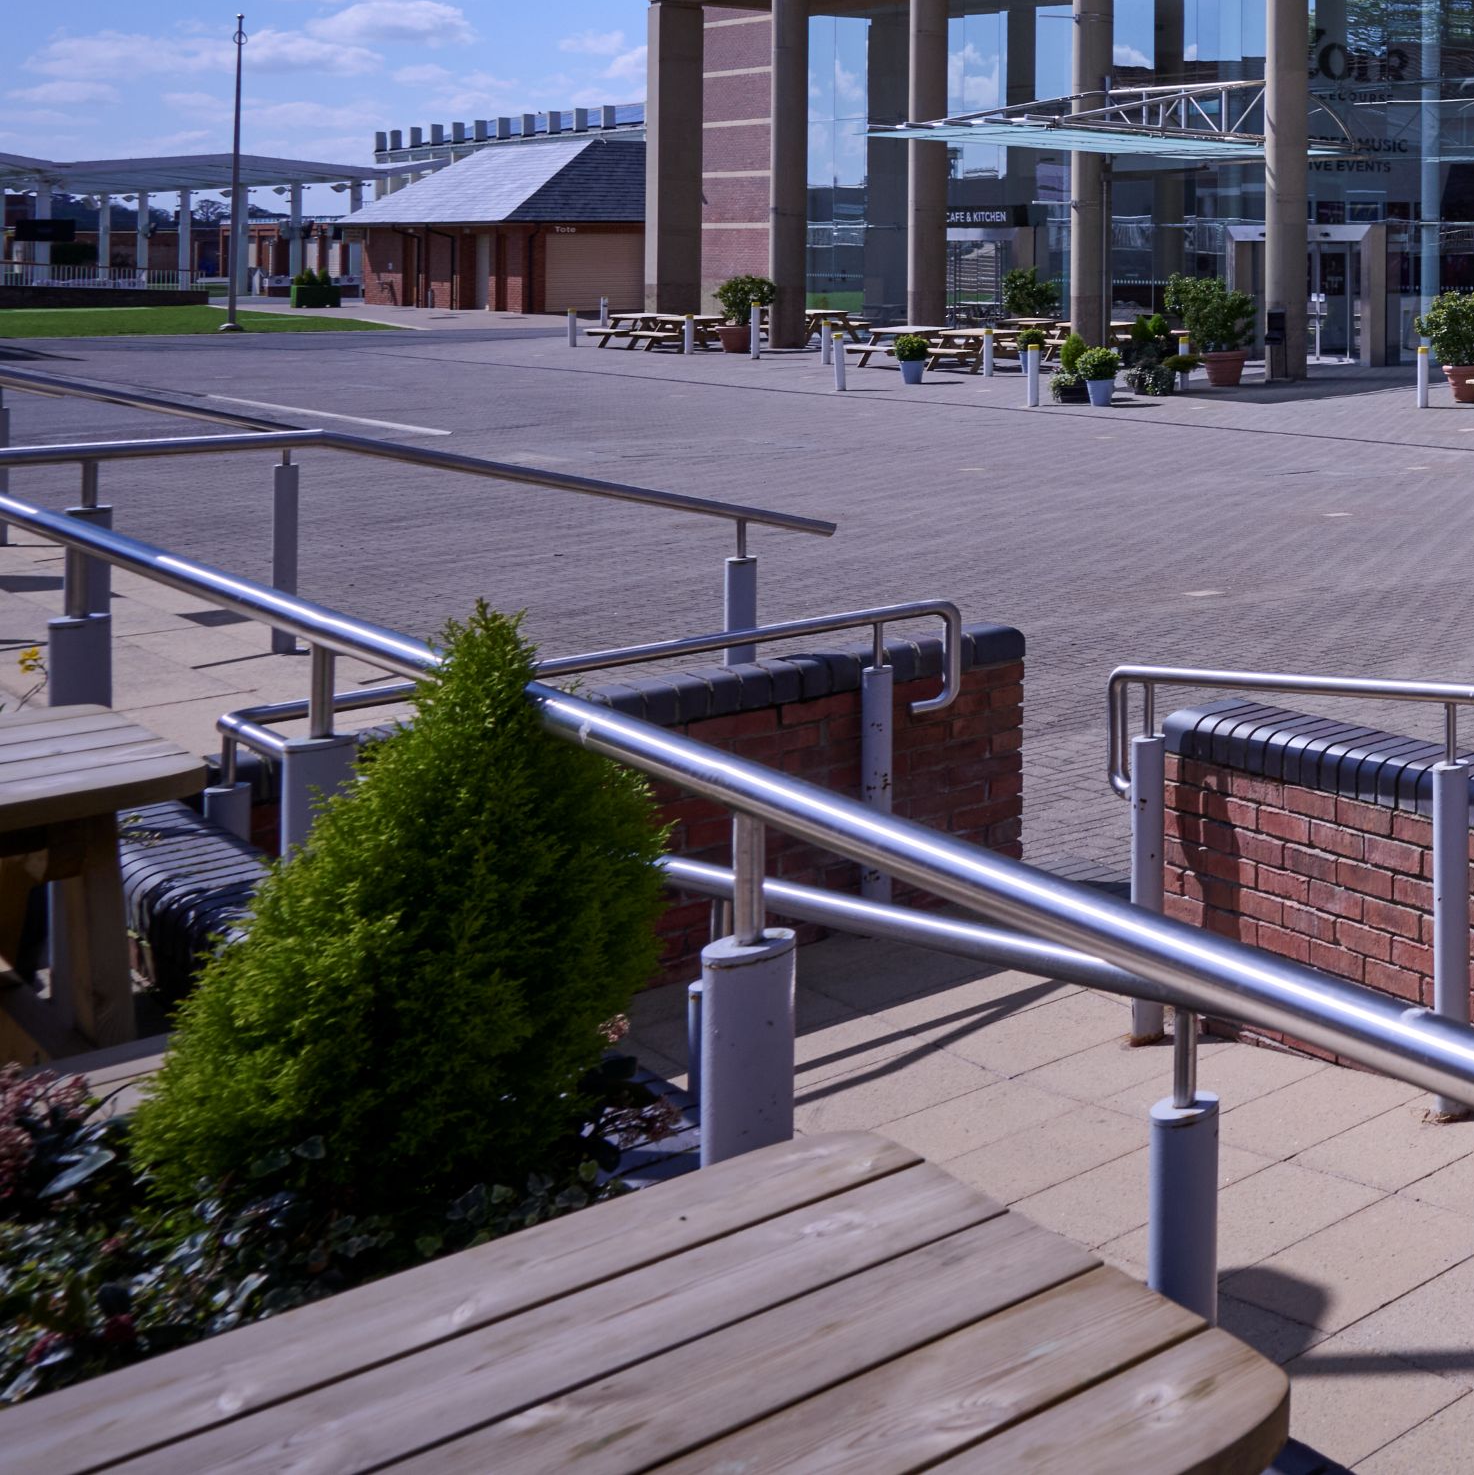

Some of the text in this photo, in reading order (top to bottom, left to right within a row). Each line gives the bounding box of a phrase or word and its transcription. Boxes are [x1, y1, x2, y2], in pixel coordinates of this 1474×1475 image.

[1309, 160, 1391, 173] IVE EVENTS
[966, 211, 972, 223] &
[973, 211, 1006, 222] KITCHEN
[554, 225, 576, 233] Tote
